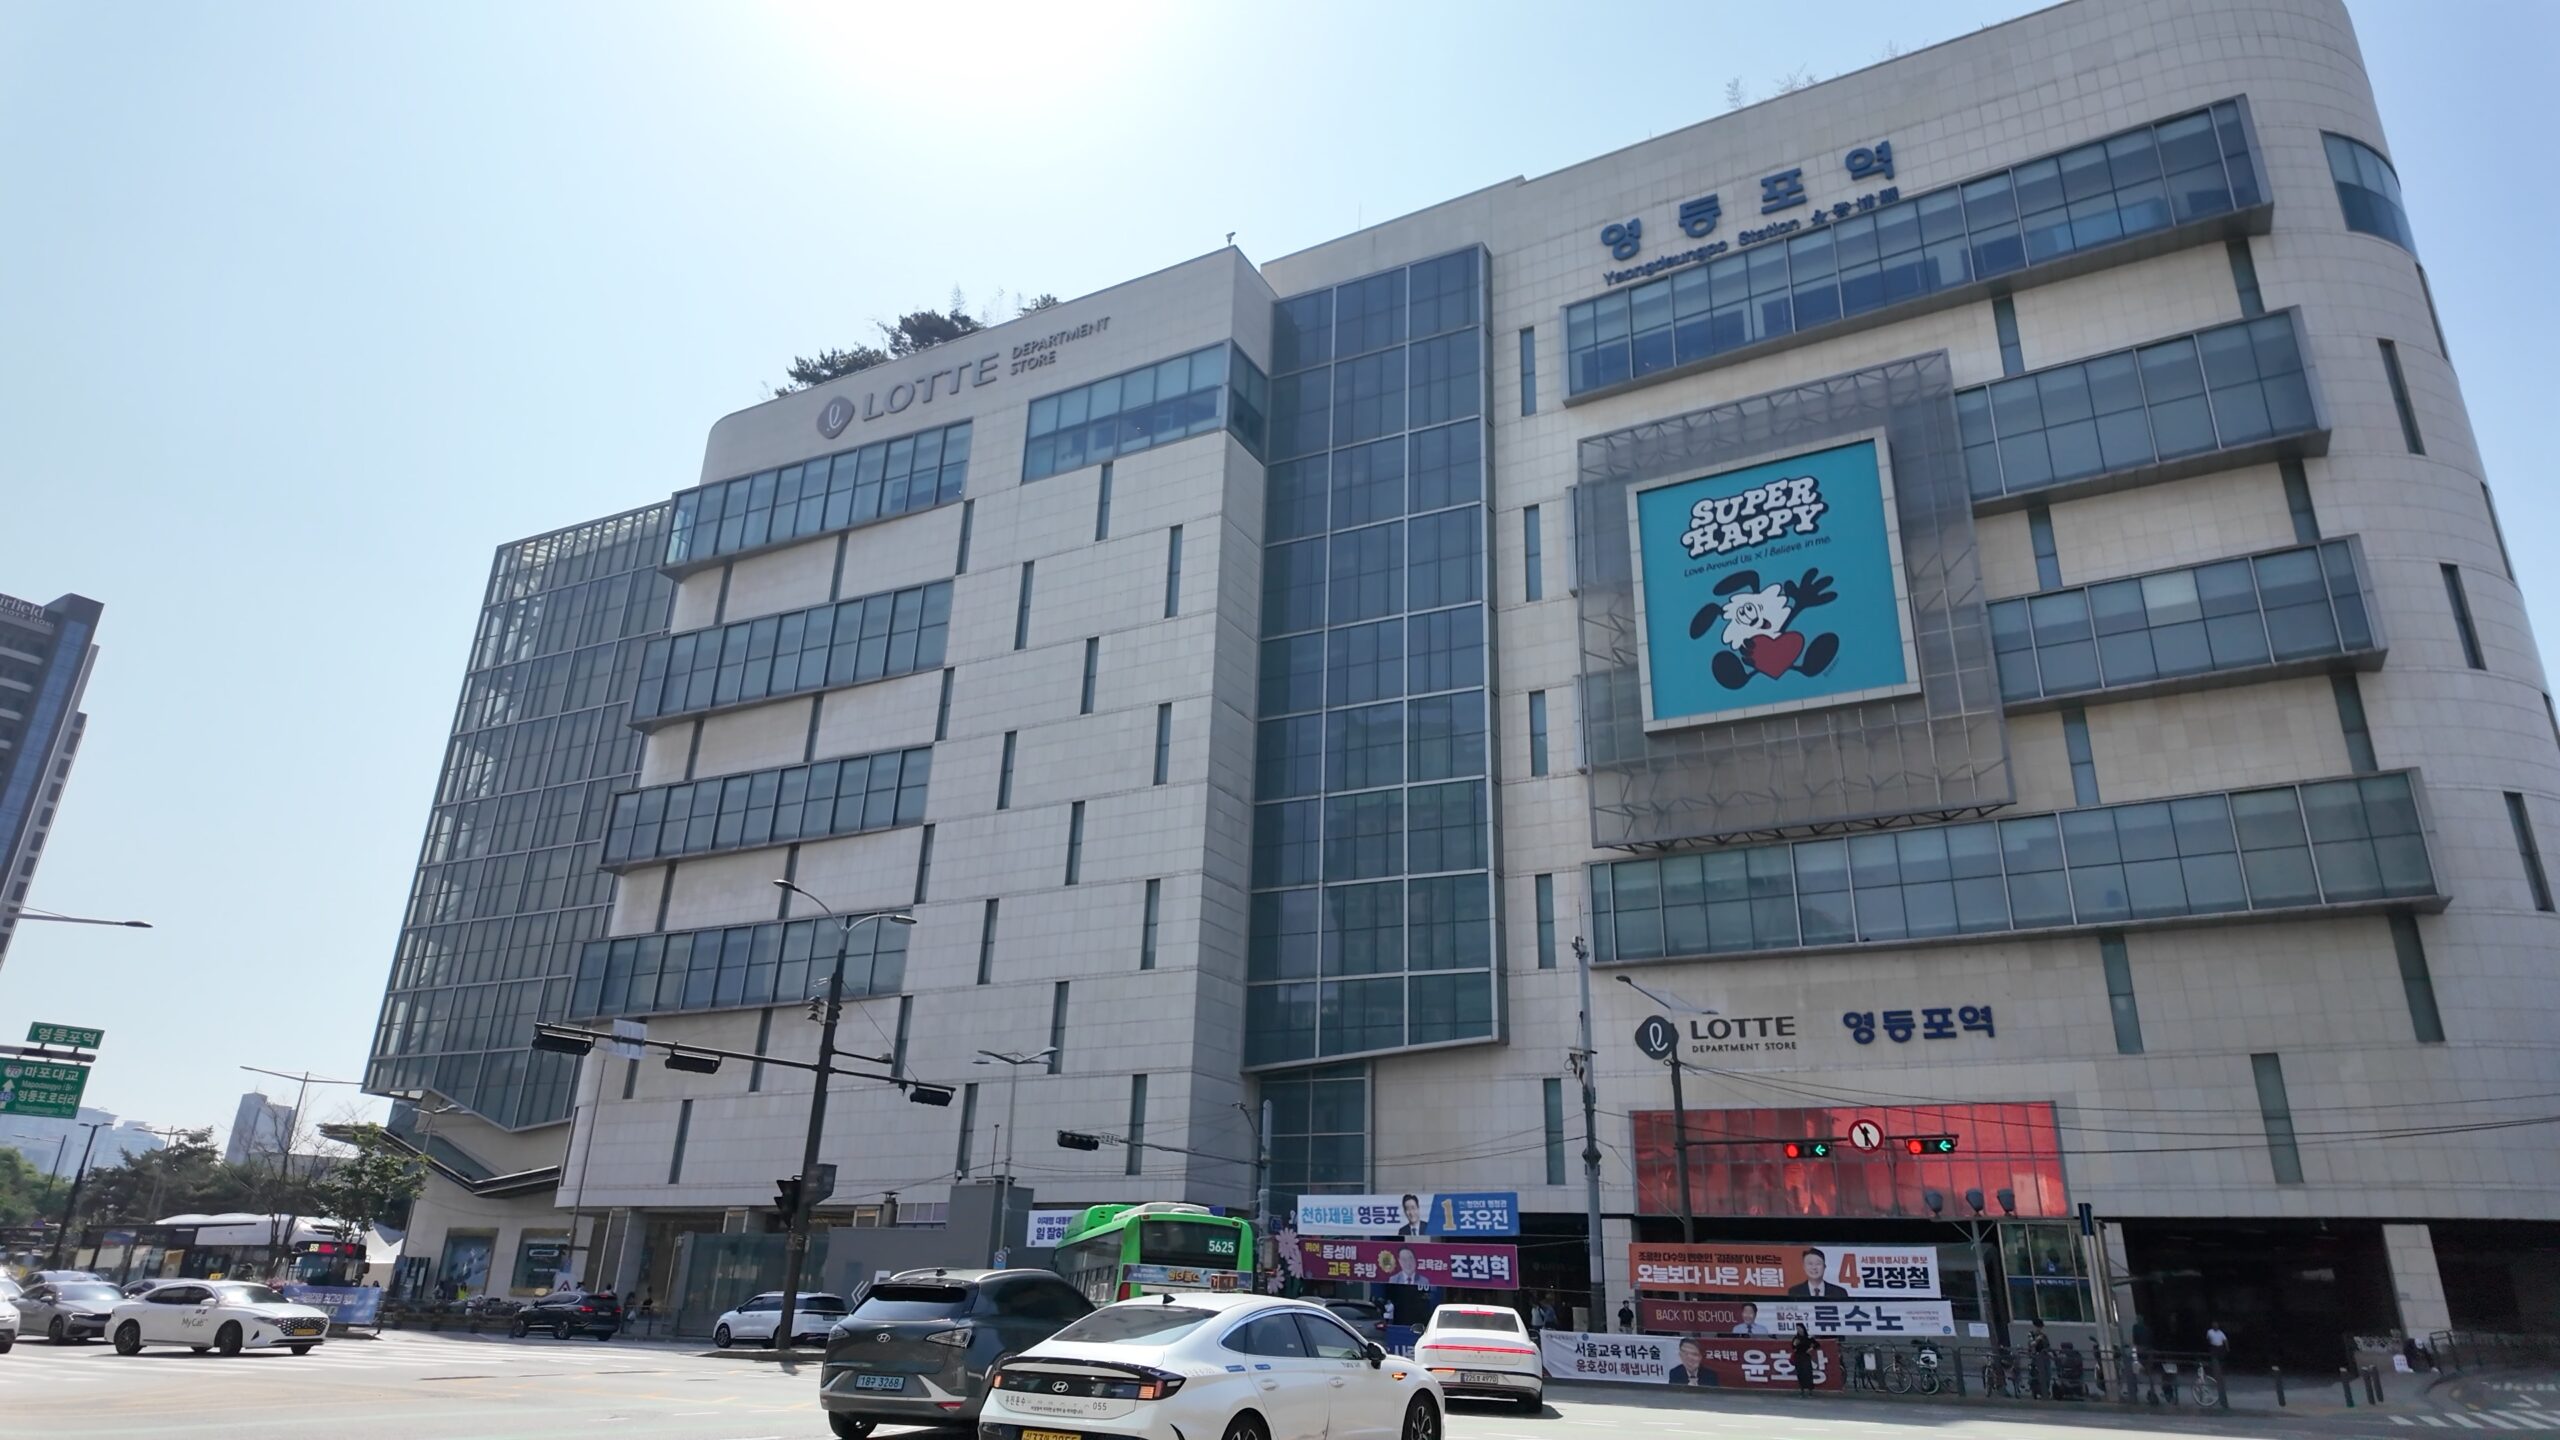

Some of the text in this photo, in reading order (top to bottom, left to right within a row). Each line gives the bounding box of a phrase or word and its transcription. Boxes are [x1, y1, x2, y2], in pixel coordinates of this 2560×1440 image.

[1600, 140, 1896, 261] 영등포역
[1738, 218, 1801, 247] Station
[1012, 316, 1110, 360] DEPARTMENT
[1010, 351, 1056, 376] STORE
[862, 352, 999, 422] LOTTE
[1690, 476, 1820, 529] SUPER
[1680, 502, 1828, 559] HAPPY
[1684, 567, 1704, 578] Love
[1706, 557, 1739, 573] Around
[1690, 1016, 1797, 1040] LOTTE
[1843, 1005, 1996, 1045] 영등포역
[38, 1028, 97, 1045] 영등포역
[1692, 1041, 1797, 1053] DEPARTMENT STORE
[24, 1066, 79, 1081] 마포대교
[18, 1090, 78, 1106] 영등포로터리
[1302, 1206, 1401, 1225] 천하제일 영등포
[1441, 1198, 1457, 1231] 1
[1459, 1209, 1509, 1231] 조유진
[1036, 1227, 1045, 1240] 일
[1209, 1240, 1235, 1254] 5625
[1323, 1244, 1357, 1260] 동성애
[1662, 1252, 1686, 1262] 다수의
[1328, 1262, 1377, 1278] 교육 추방
[1450, 1254, 1510, 1280] 조전혁
[1839, 1253, 1861, 1288] 4
[1861, 1256, 1928, 1265] 서울특별시장 후보
[1637, 1264, 1784, 1287] 오늘보다 나은 서울!
[1861, 1266, 1930, 1289] 김정철
[1655, 1309, 1737, 1323] BACK TO SCHOOL
[1814, 1305, 1904, 1332] 류수노
[1575, 1342, 1661, 1360] 서울교육 대수술
[1576, 1359, 1664, 1376] 윤호상이 해냅니다!
[878, 1377, 900, 1388] 3268
[1093, 1401, 1107, 1411] 055
